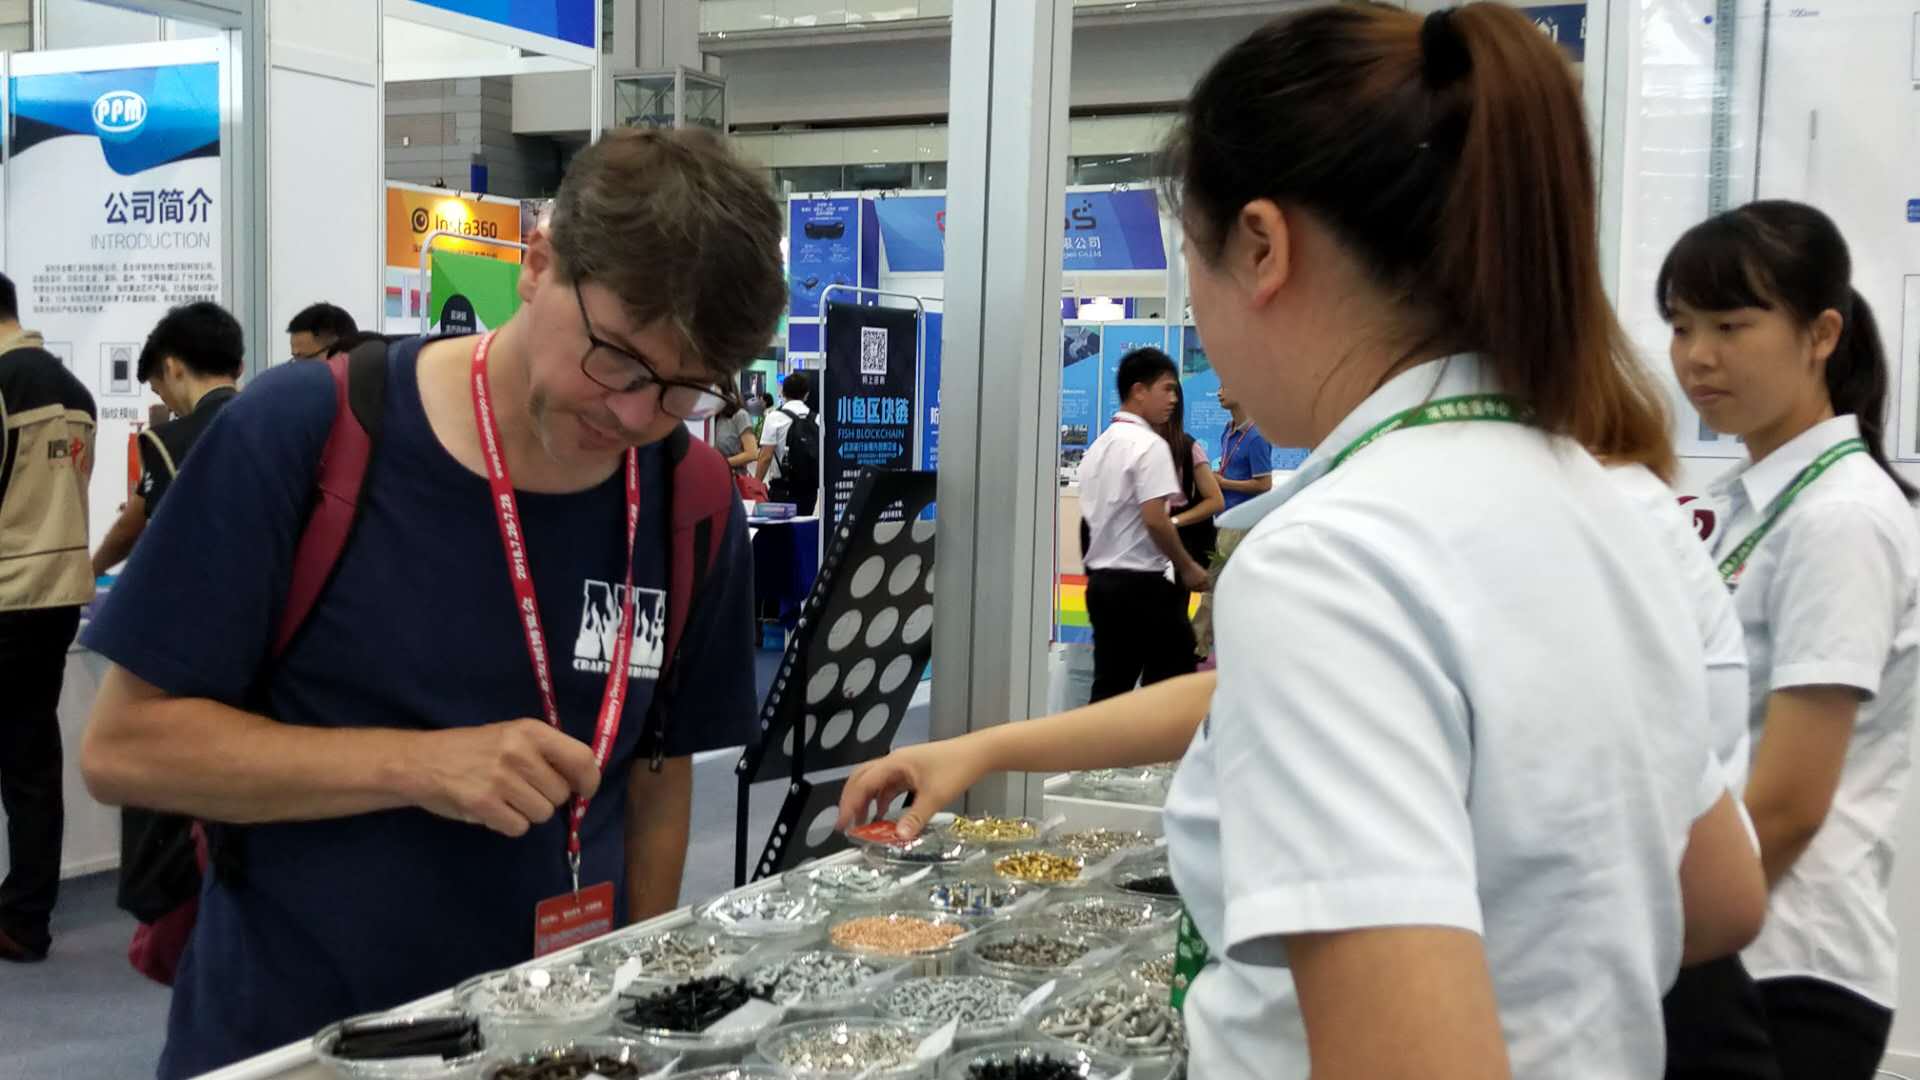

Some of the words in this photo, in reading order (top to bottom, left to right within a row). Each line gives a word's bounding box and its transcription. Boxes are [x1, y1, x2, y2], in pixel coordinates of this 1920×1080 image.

[97, 98, 142, 123] PPM
[104, 187, 213, 225] 公司简介
[90, 231, 211, 251] INTRODUCTION
[837, 396, 909, 424] 小鱼区块链
[838, 428, 855, 440] FISH
[856, 428, 905, 440] BLOCKCHAIN
